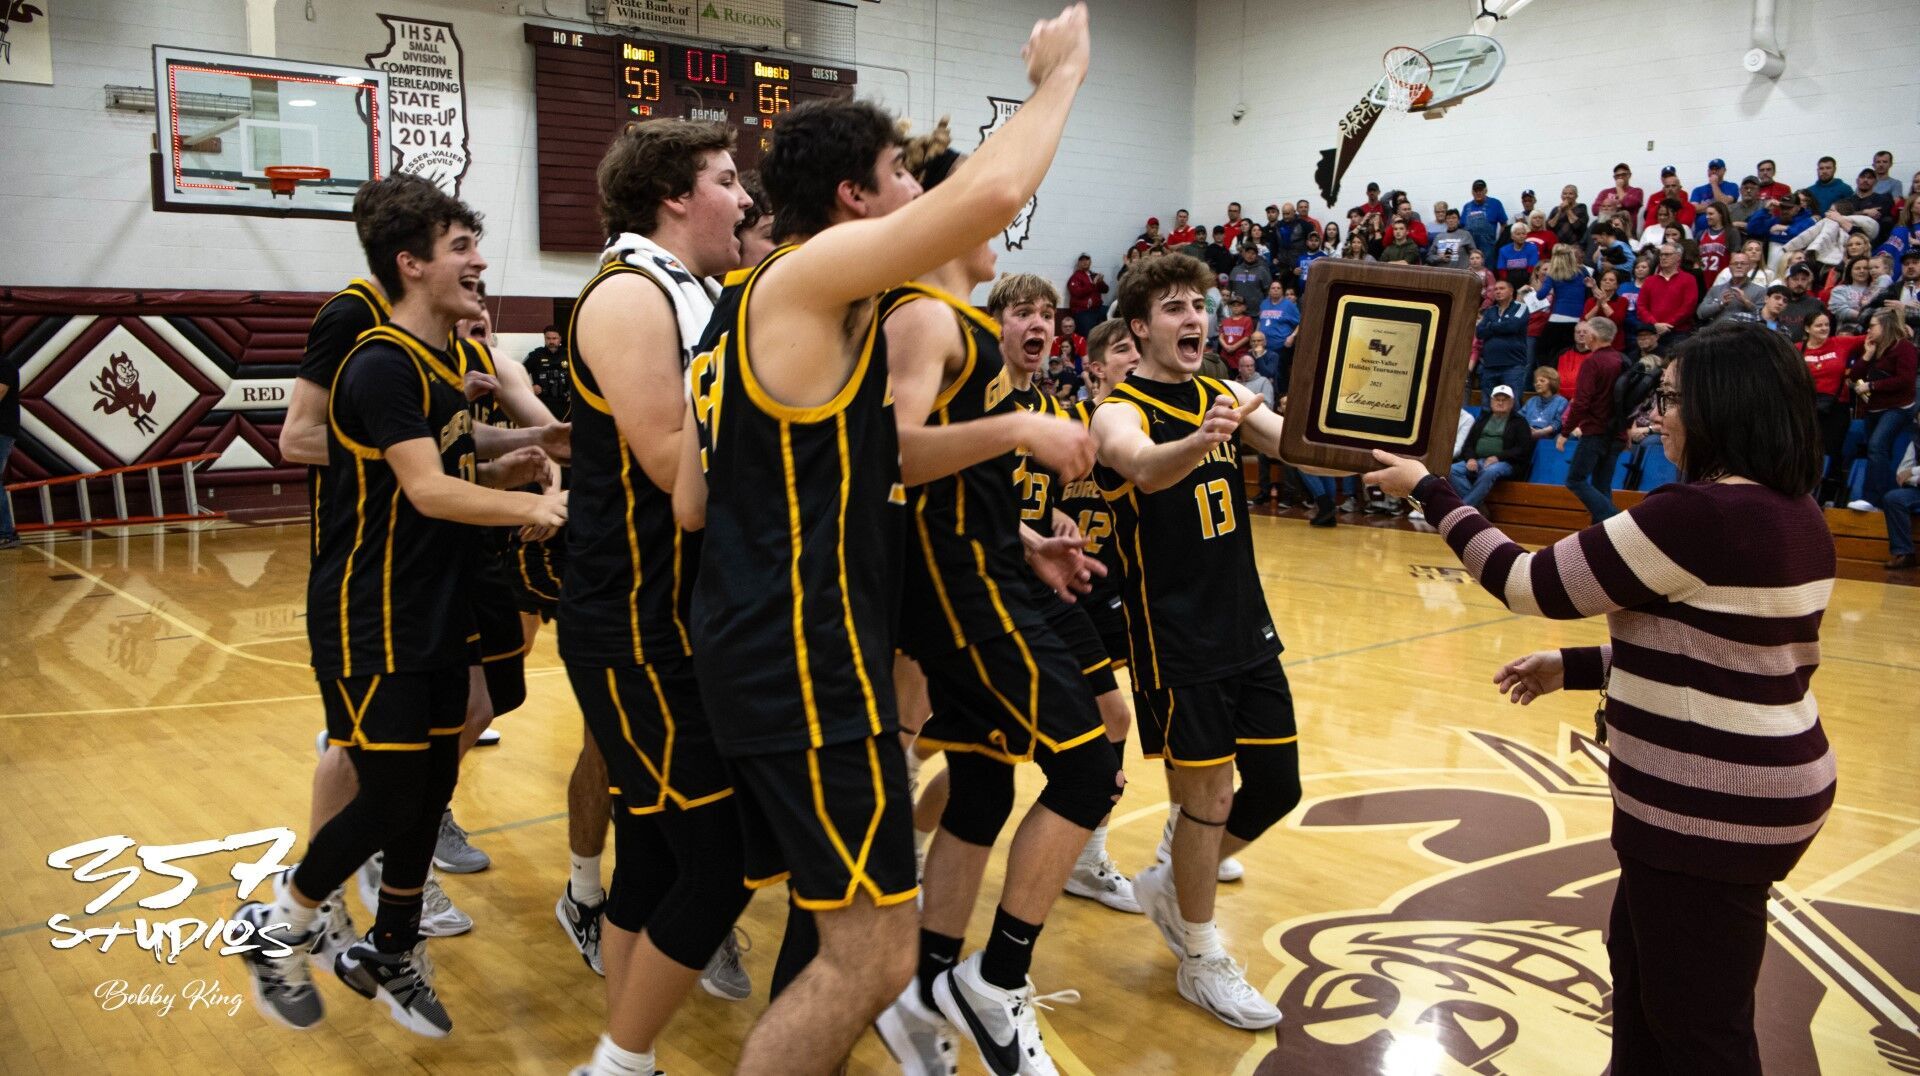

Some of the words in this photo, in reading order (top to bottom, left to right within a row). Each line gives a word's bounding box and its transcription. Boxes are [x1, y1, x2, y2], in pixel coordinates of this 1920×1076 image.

[616, 6, 686, 26] Whittington
[646, 0, 675, 14] Bank
[678, 6, 691, 17] of
[401, 24, 446, 43] IHSA
[409, 41, 439, 53] SMALL
[623, 43, 655, 62] Home
[403, 52, 446, 65] DIVISION
[687, 50, 727, 84] 0.0
[381, 62, 453, 79] COMPETITIVE
[754, 61, 790, 80] Guests
[812, 67, 838, 81] GUESTS
[390, 77, 460, 93] EERLEADING
[625, 66, 660, 101] 59
[390, 90, 440, 108] STATE
[391, 107, 456, 126] NNER-UP
[691, 107, 728, 122] period
[1000, 103, 1018, 116] IHS
[399, 128, 452, 148] 2014
[404, 150, 463, 173] ESSER-VALIER
[427, 157, 453, 167] DEVILS
[1348, 363, 1371, 372] Holiday
[1373, 365, 1408, 376] Tournament
[241, 386, 285, 401] RED
[1345, 392, 1402, 410] Champions
[1195, 478, 1237, 539] 13
[1078, 509, 1113, 554] 12
